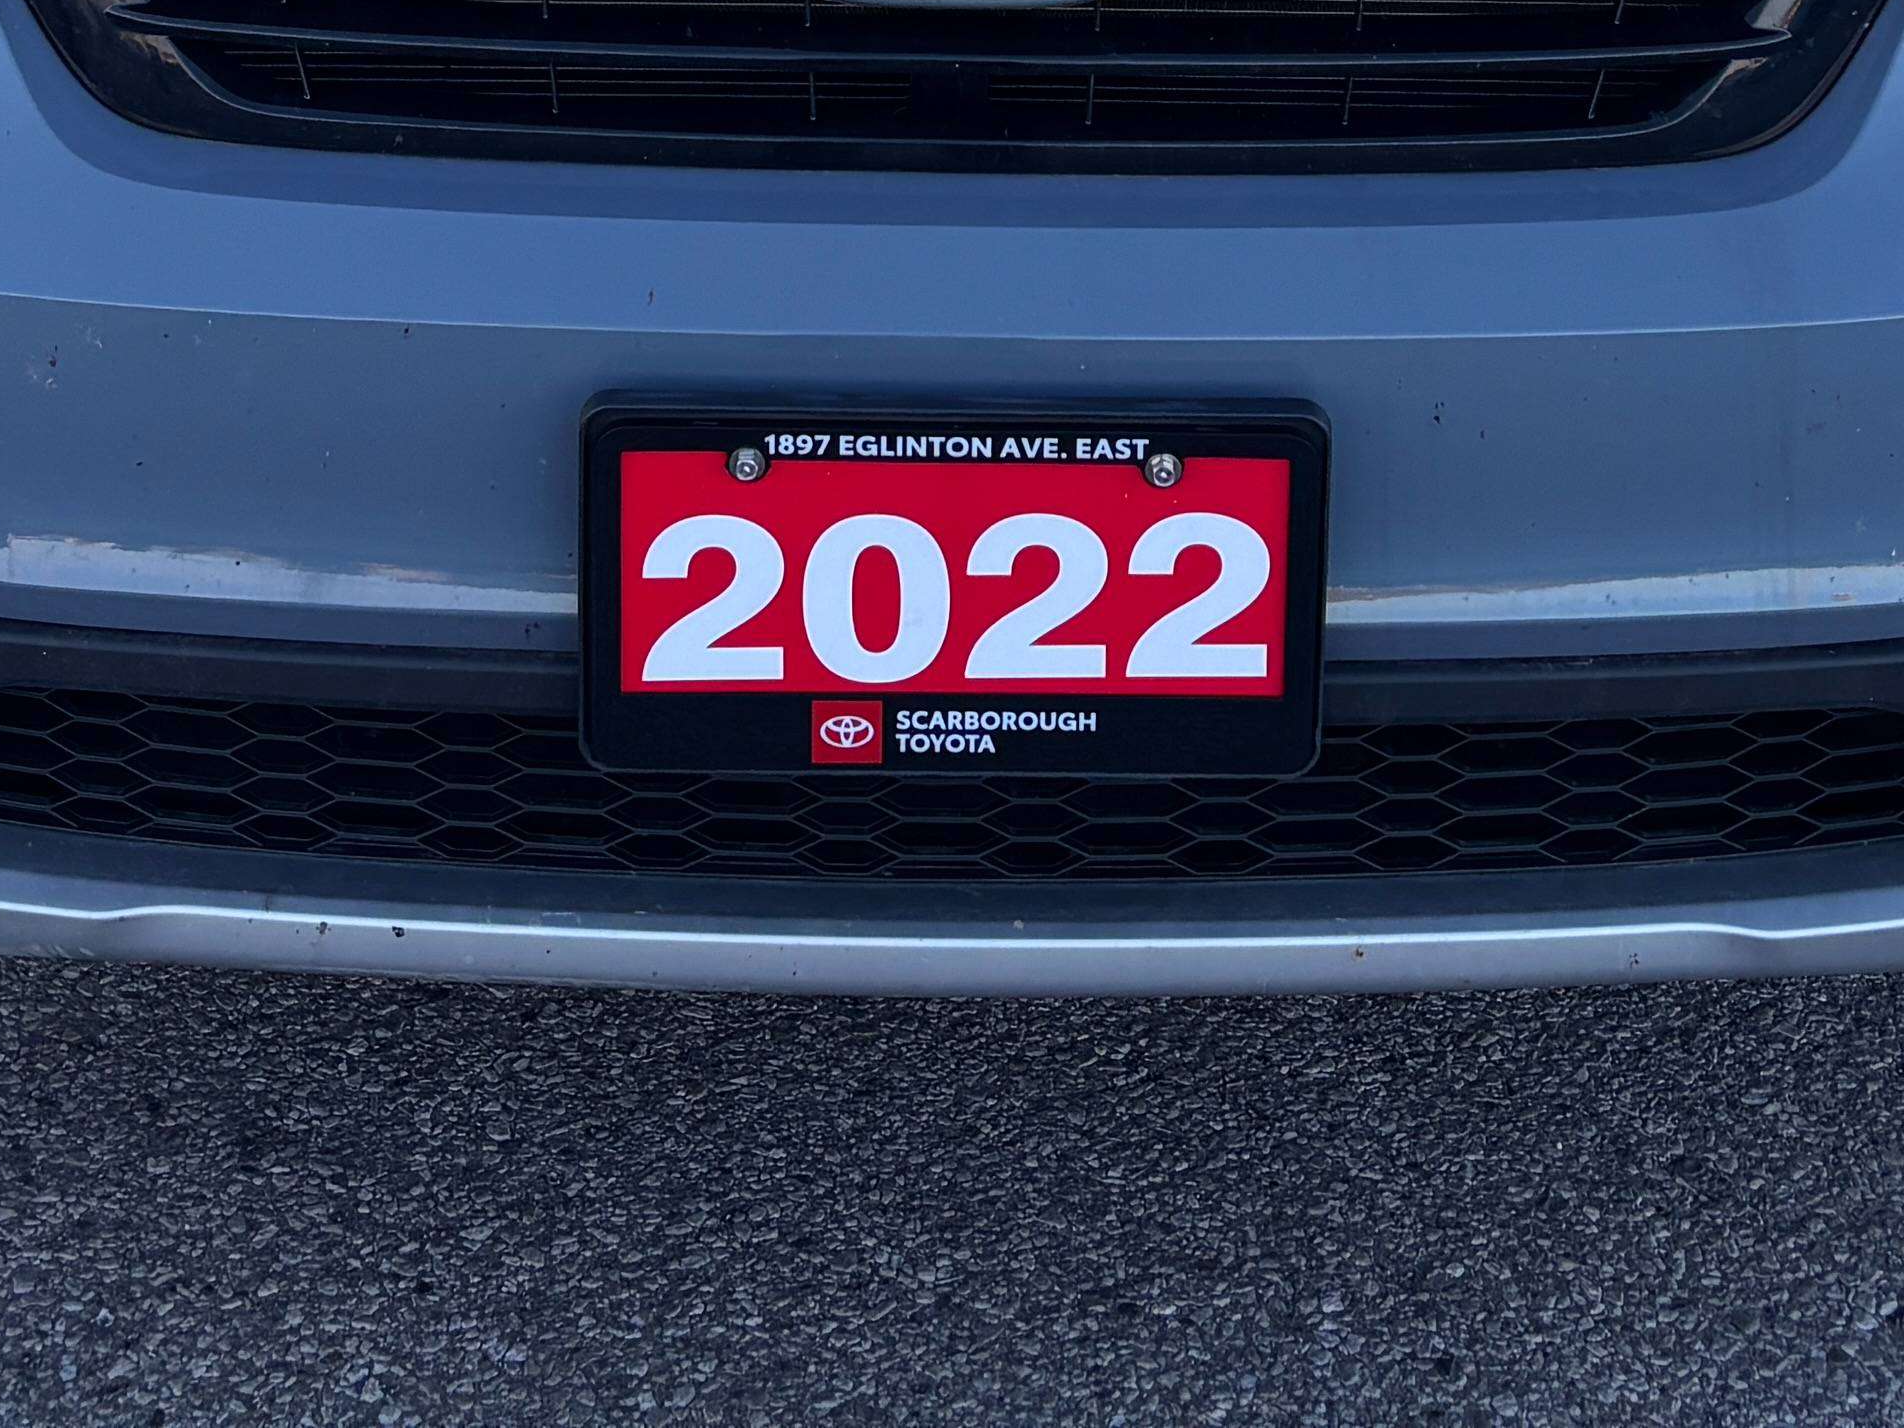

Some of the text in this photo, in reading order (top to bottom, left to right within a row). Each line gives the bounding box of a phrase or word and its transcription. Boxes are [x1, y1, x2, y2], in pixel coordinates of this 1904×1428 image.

[764, 434, 1149, 461] 1897 EGLINTON AVE. EAST
[641, 511, 1271, 684] 2022
[896, 710, 1097, 732] SCARBOROUGH
[895, 734, 996, 753] TOYOTA
